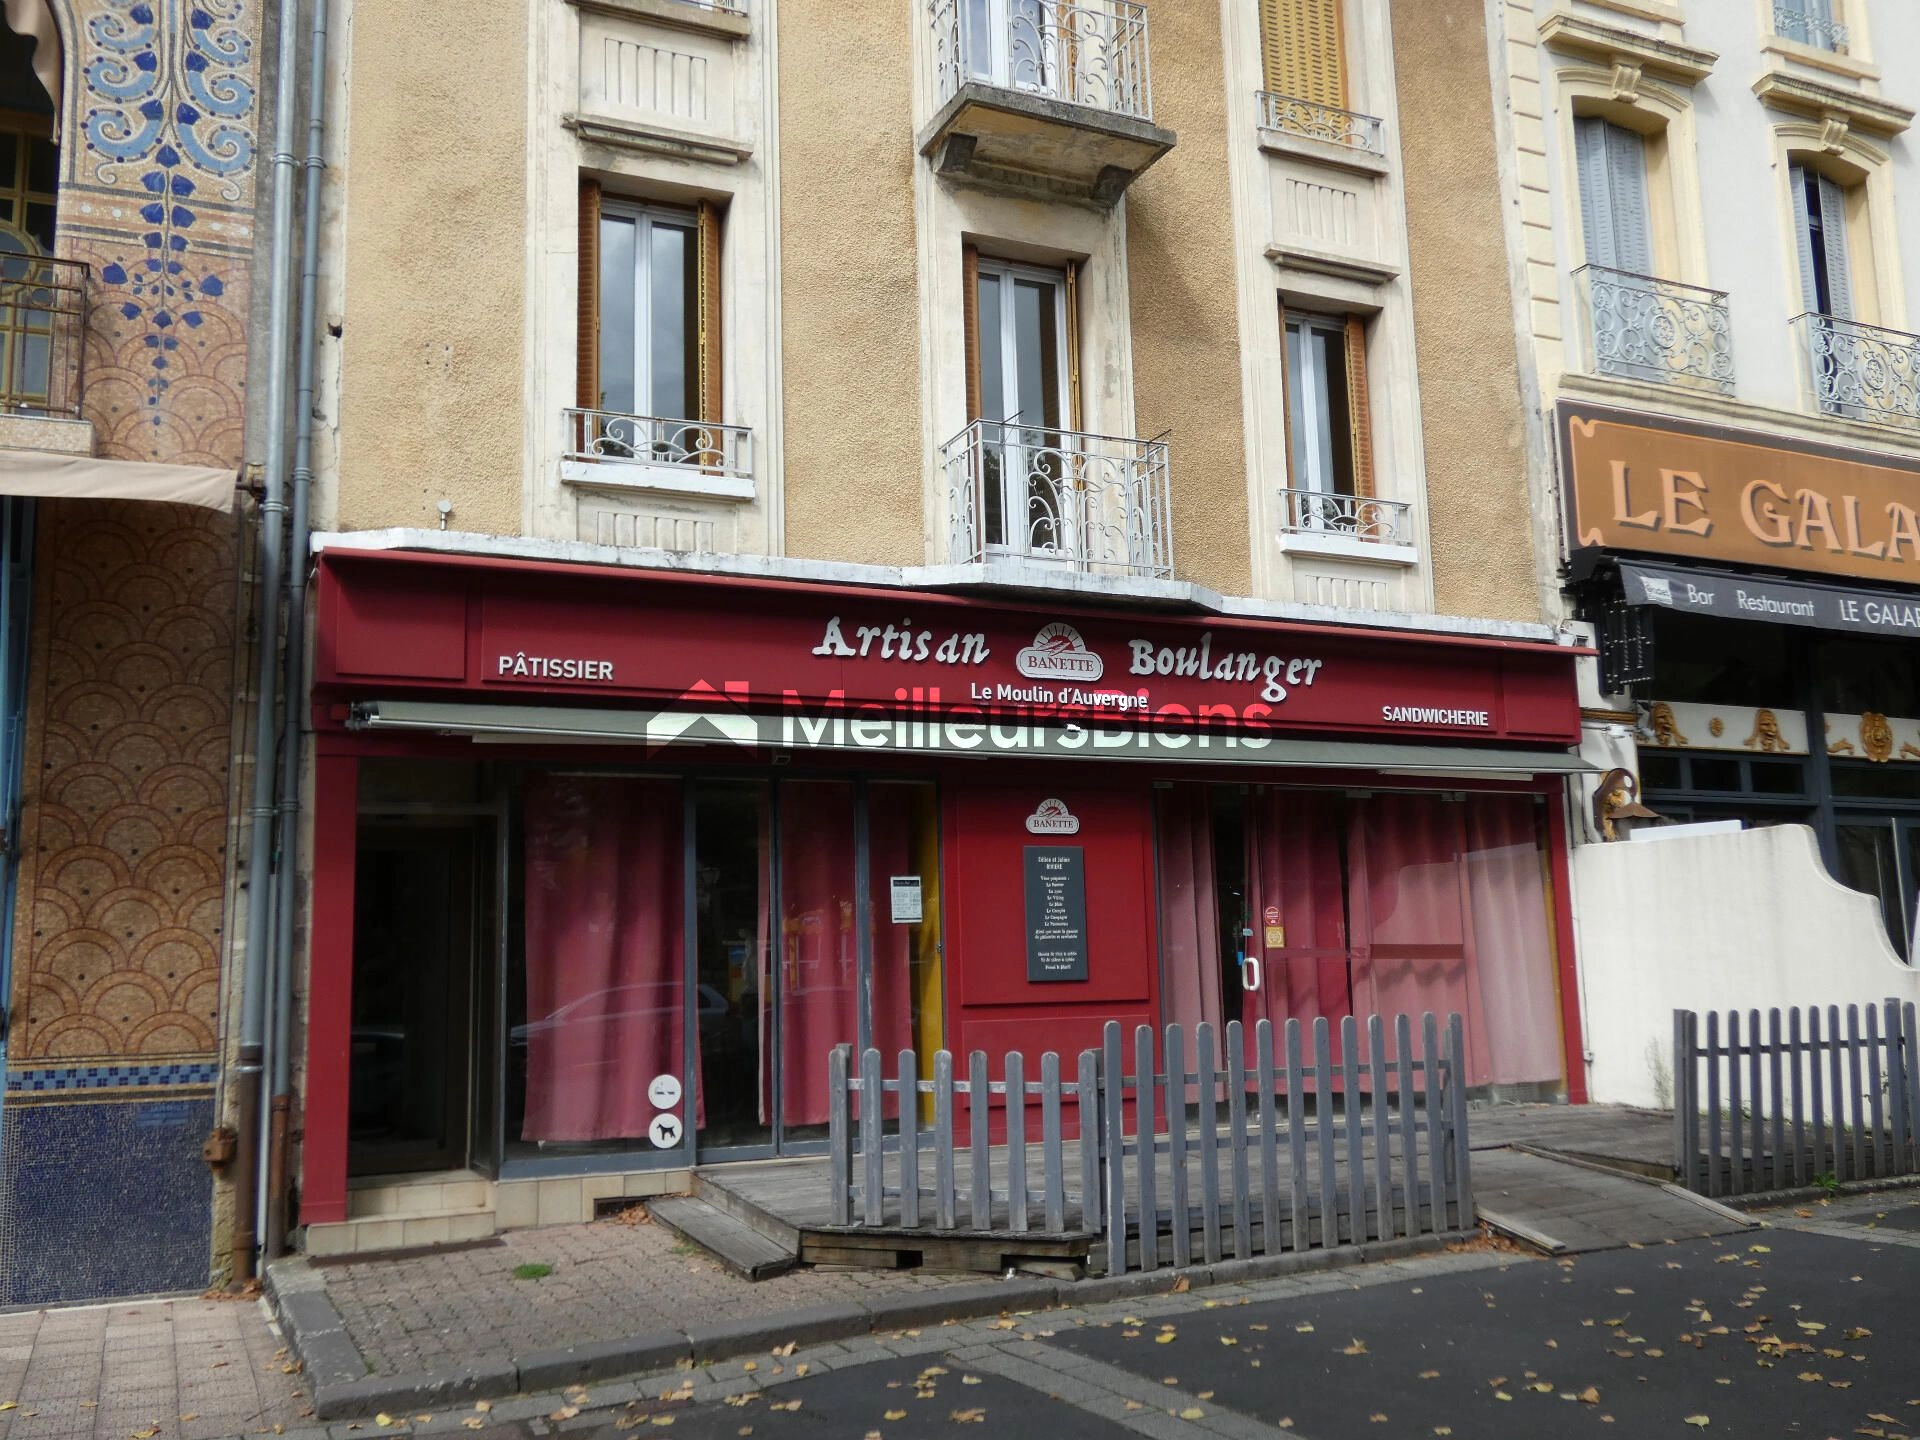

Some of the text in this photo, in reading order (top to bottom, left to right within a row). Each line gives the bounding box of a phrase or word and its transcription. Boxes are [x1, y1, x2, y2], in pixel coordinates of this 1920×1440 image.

[1609, 460, 1711, 536] LE
[1687, 583, 1714, 605] Bar
[1736, 589, 1815, 617] Restaurant
[1839, 599, 1860, 622] LE
[812, 616, 990, 665] Artisan
[498, 652, 613, 680] PÂTISSIER
[1028, 656, 1094, 672] BANETTE
[1128, 632, 1323, 702] Boulanger
[971, 683, 992, 700] Le
[997, 685, 1054, 703] Moulin
[1382, 705, 1489, 726] SANDWICHERIE
[1033, 819, 1074, 829] BANETTE
